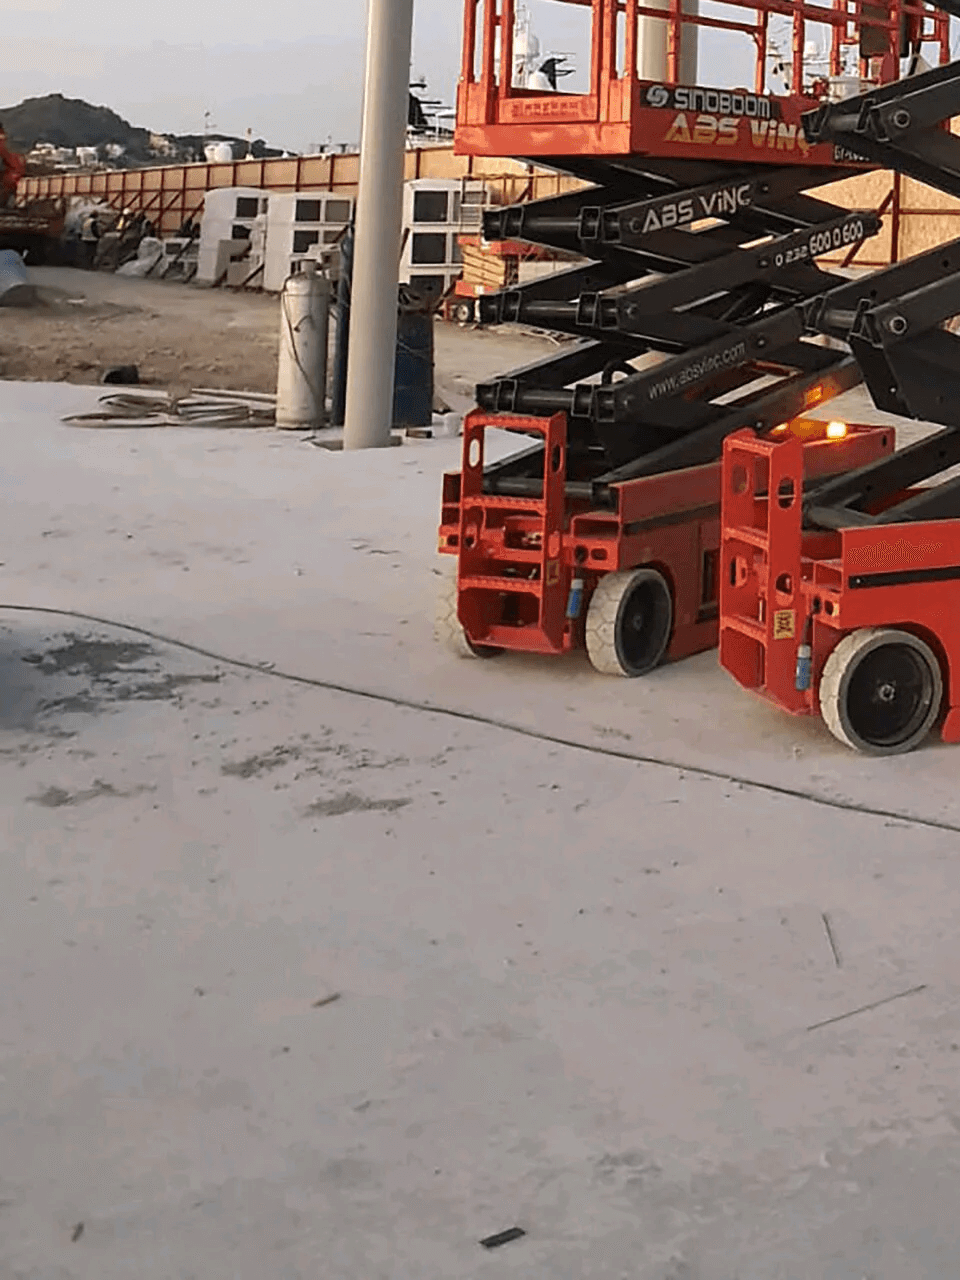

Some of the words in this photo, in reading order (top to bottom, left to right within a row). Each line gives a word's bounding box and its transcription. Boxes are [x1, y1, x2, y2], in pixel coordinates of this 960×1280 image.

[674, 87, 771, 119] SINOBOOM
[663, 112, 741, 146] ABS
[642, 199, 694, 234] ABS
[775, 253, 784, 267] 0
[785, 245, 809, 263] 232
[809, 230, 832, 255] 600
[833, 227, 841, 247] 0
[842, 220, 864, 243] 600
